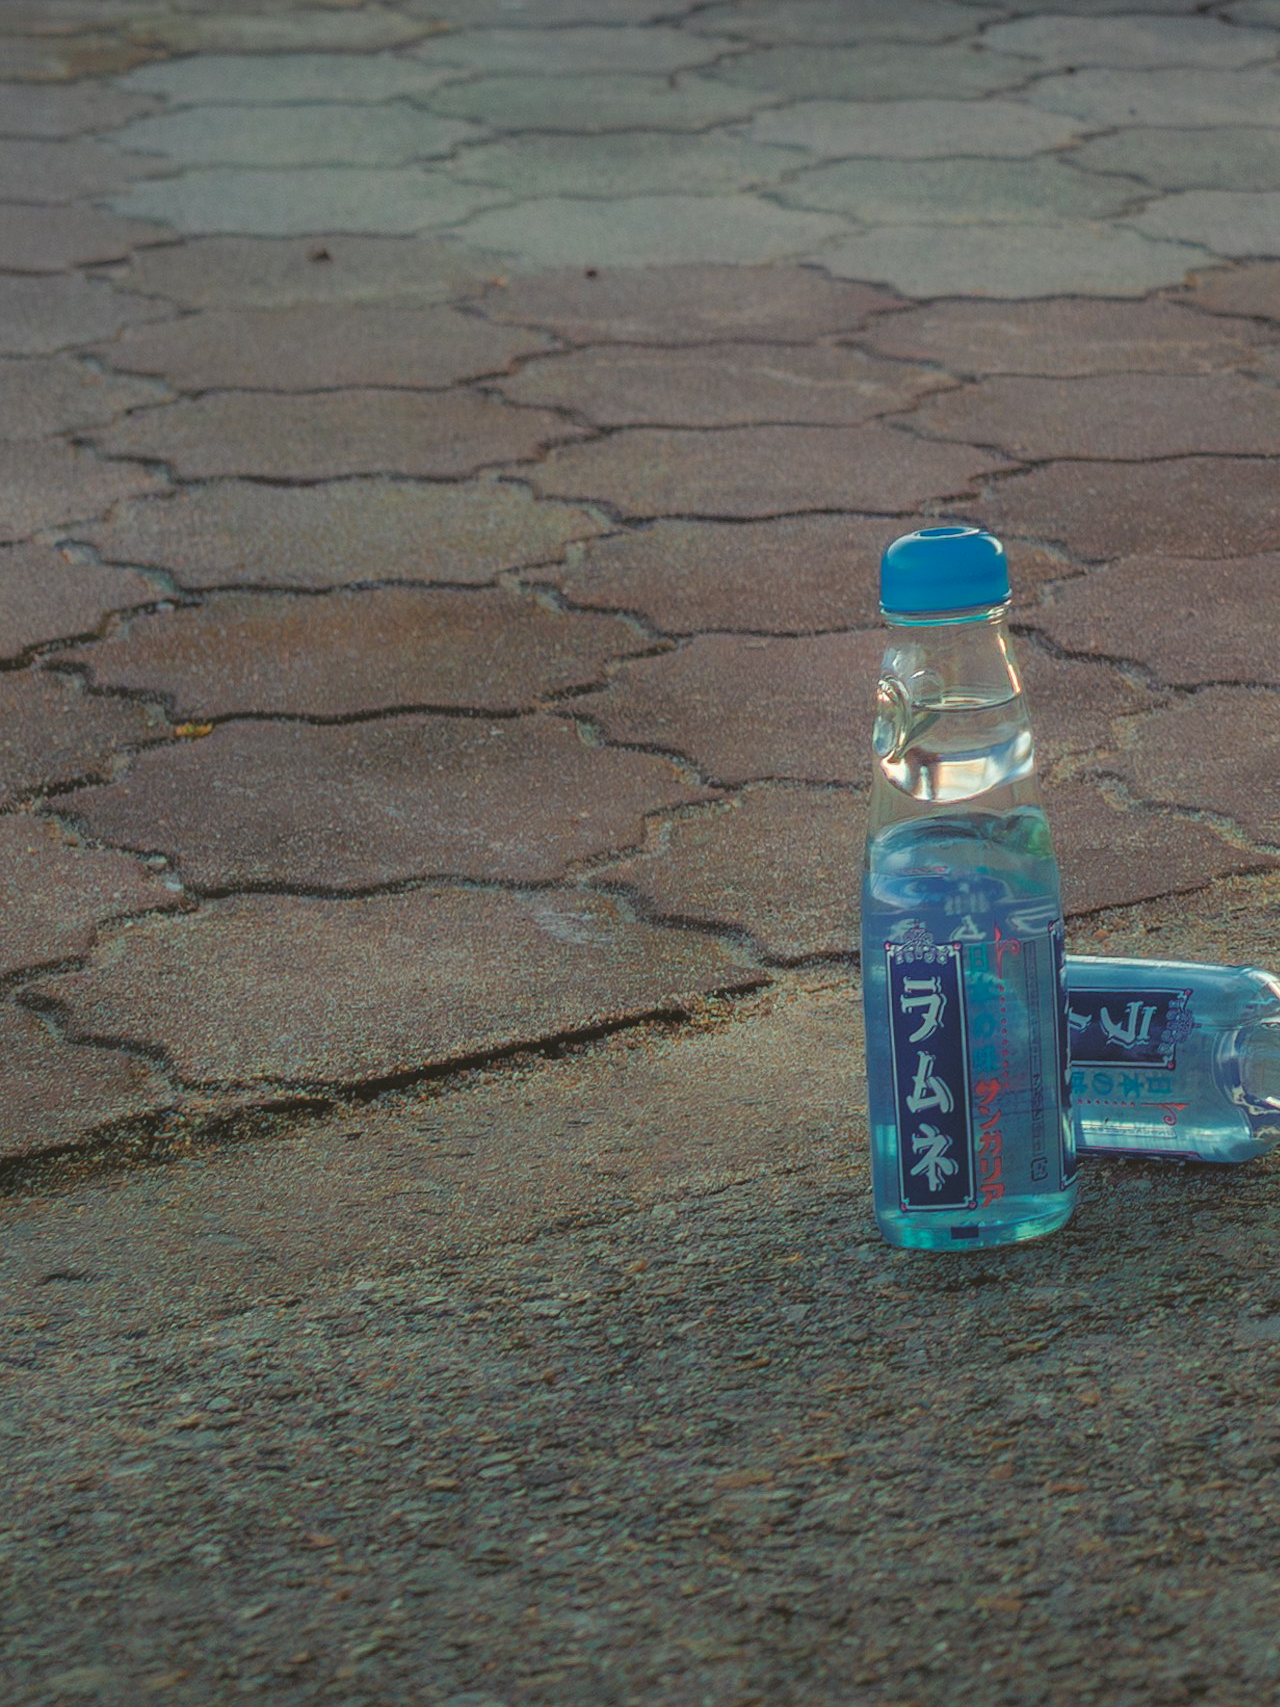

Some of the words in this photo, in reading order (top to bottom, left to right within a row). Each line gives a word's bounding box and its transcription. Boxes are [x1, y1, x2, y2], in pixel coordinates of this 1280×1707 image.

[901, 977, 960, 1191] ラムネ
[974, 1077, 1005, 1208] サンガリア
